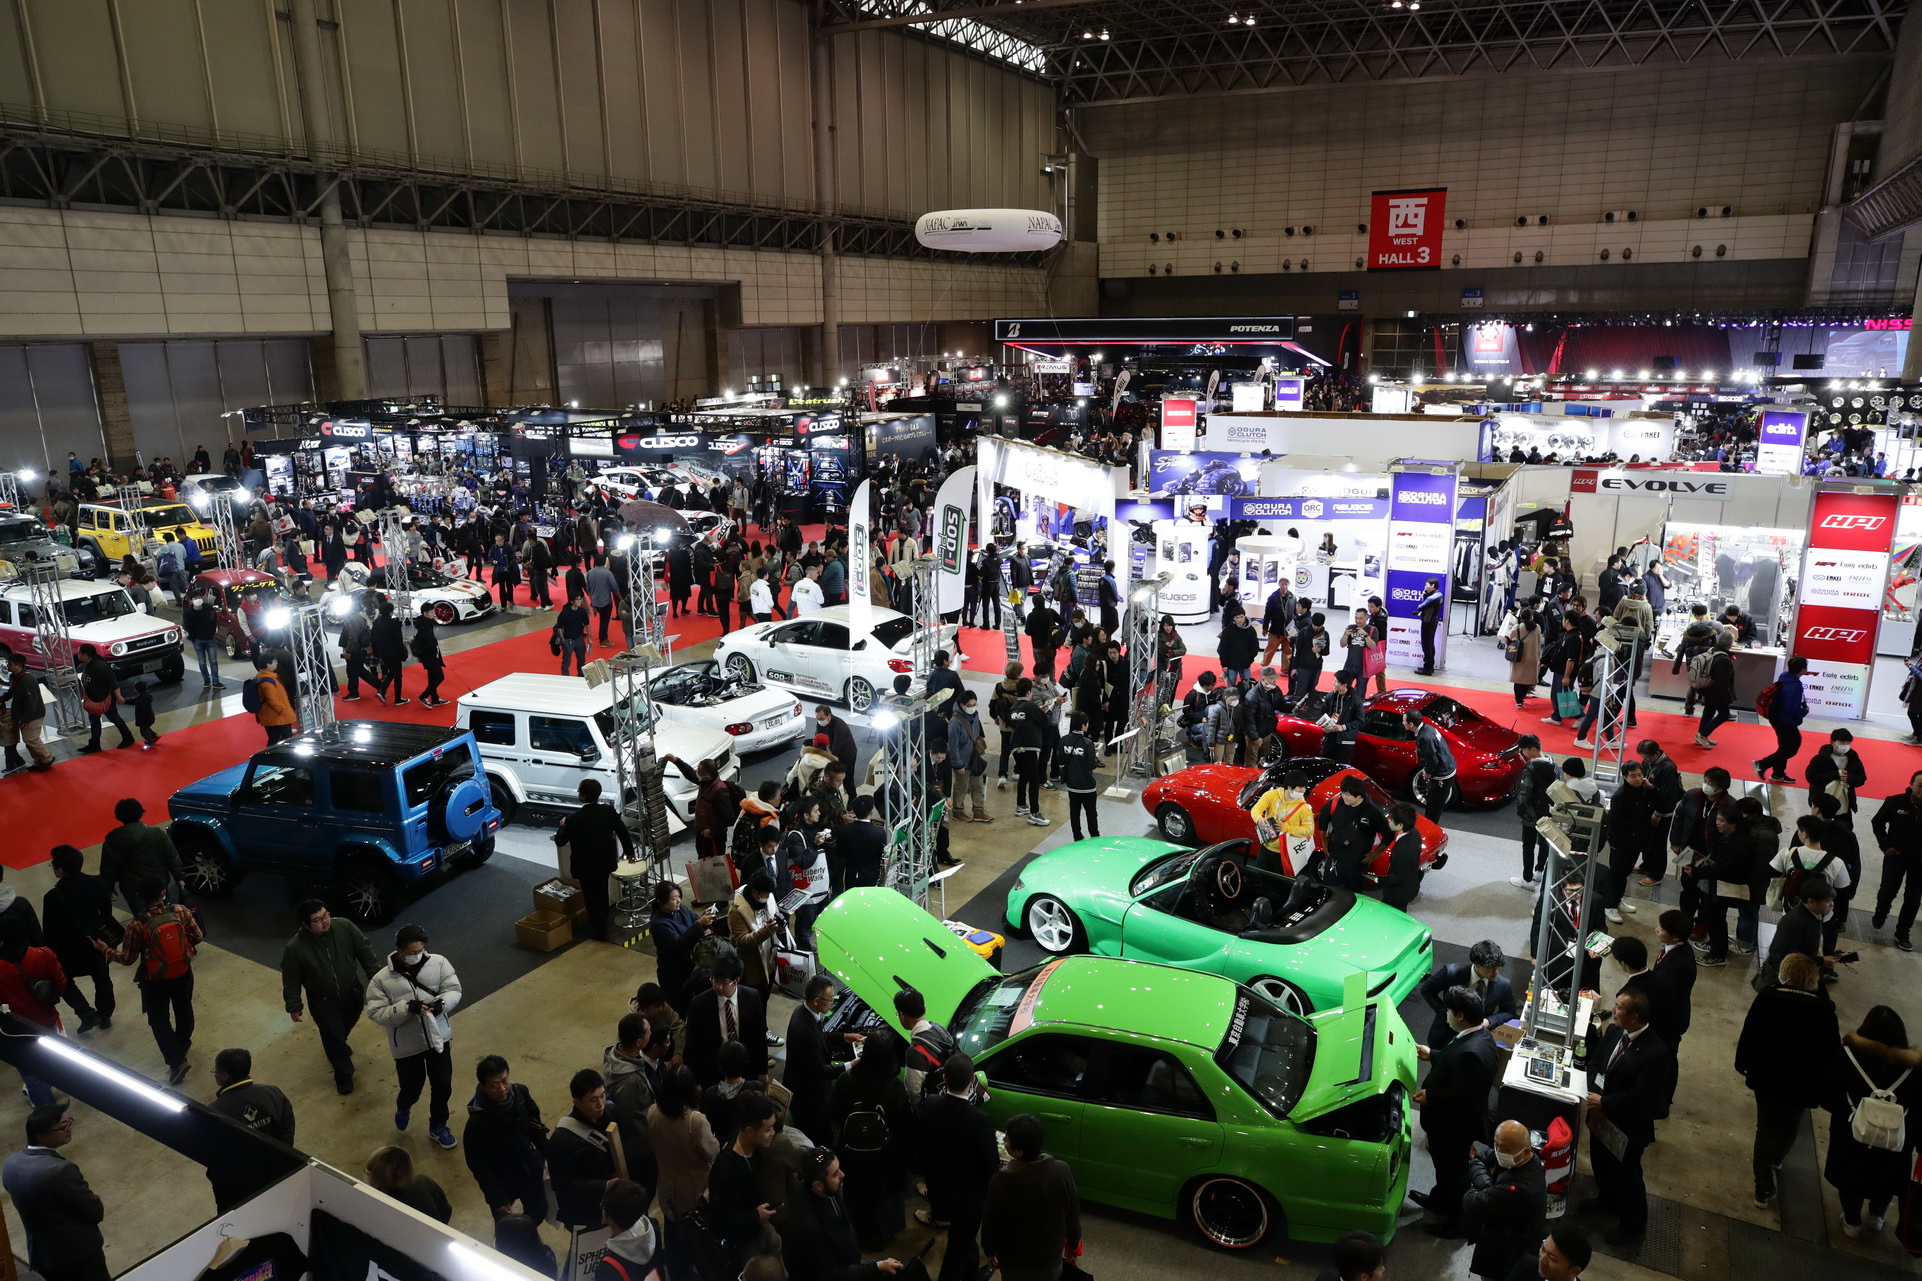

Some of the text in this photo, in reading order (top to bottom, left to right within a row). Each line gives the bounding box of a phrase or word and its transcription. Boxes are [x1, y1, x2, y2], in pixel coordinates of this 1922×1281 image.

[924, 216, 951, 231] NAPAC
[1028, 216, 1054, 230] NAPAC
[1388, 197, 1428, 236] 西
[1393, 237, 1418, 245] WEST
[1379, 246, 1430, 264] HALL 3
[1475, 289, 1481, 297] 3
[332, 425, 367, 438] CUSCO
[809, 419, 840, 433] CUSCO
[640, 436, 699, 449] CUSCO
[1601, 478, 1727, 494] EVOLVE
[1820, 514, 1887, 530] HPI
[1803, 626, 1868, 642] HPI
[1822, 671, 1838, 679] Ewig
[1840, 672, 1859, 681] edirb
[803, 866, 825, 877] Liberty
[807, 874, 824, 883] Walk
[784, 964, 806, 978] Liberty
[247, 1116, 271, 1129] NAULT
[578, 1247, 608, 1265] SPHE
[584, 1261, 600, 1275] LIG
